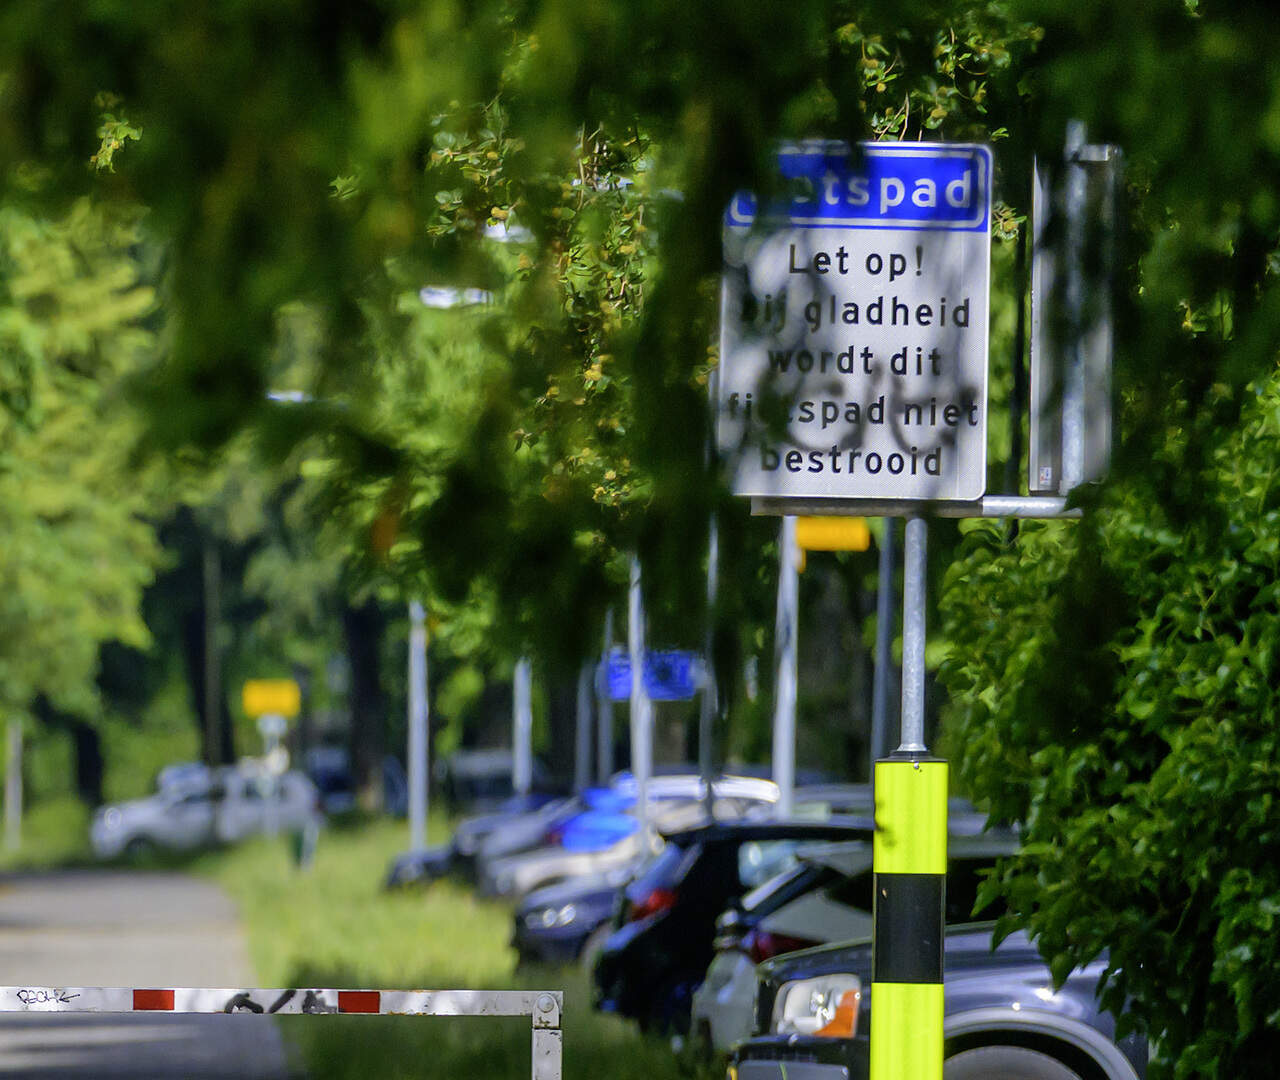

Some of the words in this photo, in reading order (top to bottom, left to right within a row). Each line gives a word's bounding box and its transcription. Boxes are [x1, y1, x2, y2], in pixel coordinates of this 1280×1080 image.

[789, 244, 849, 275] Let
[865, 245, 924, 282] op!
[804, 294, 970, 334] gladheid
[768, 345, 873, 375] wordt
[890, 346, 941, 375] dit
[903, 397, 979, 427] niet
[760, 441, 941, 476] bestrooid
